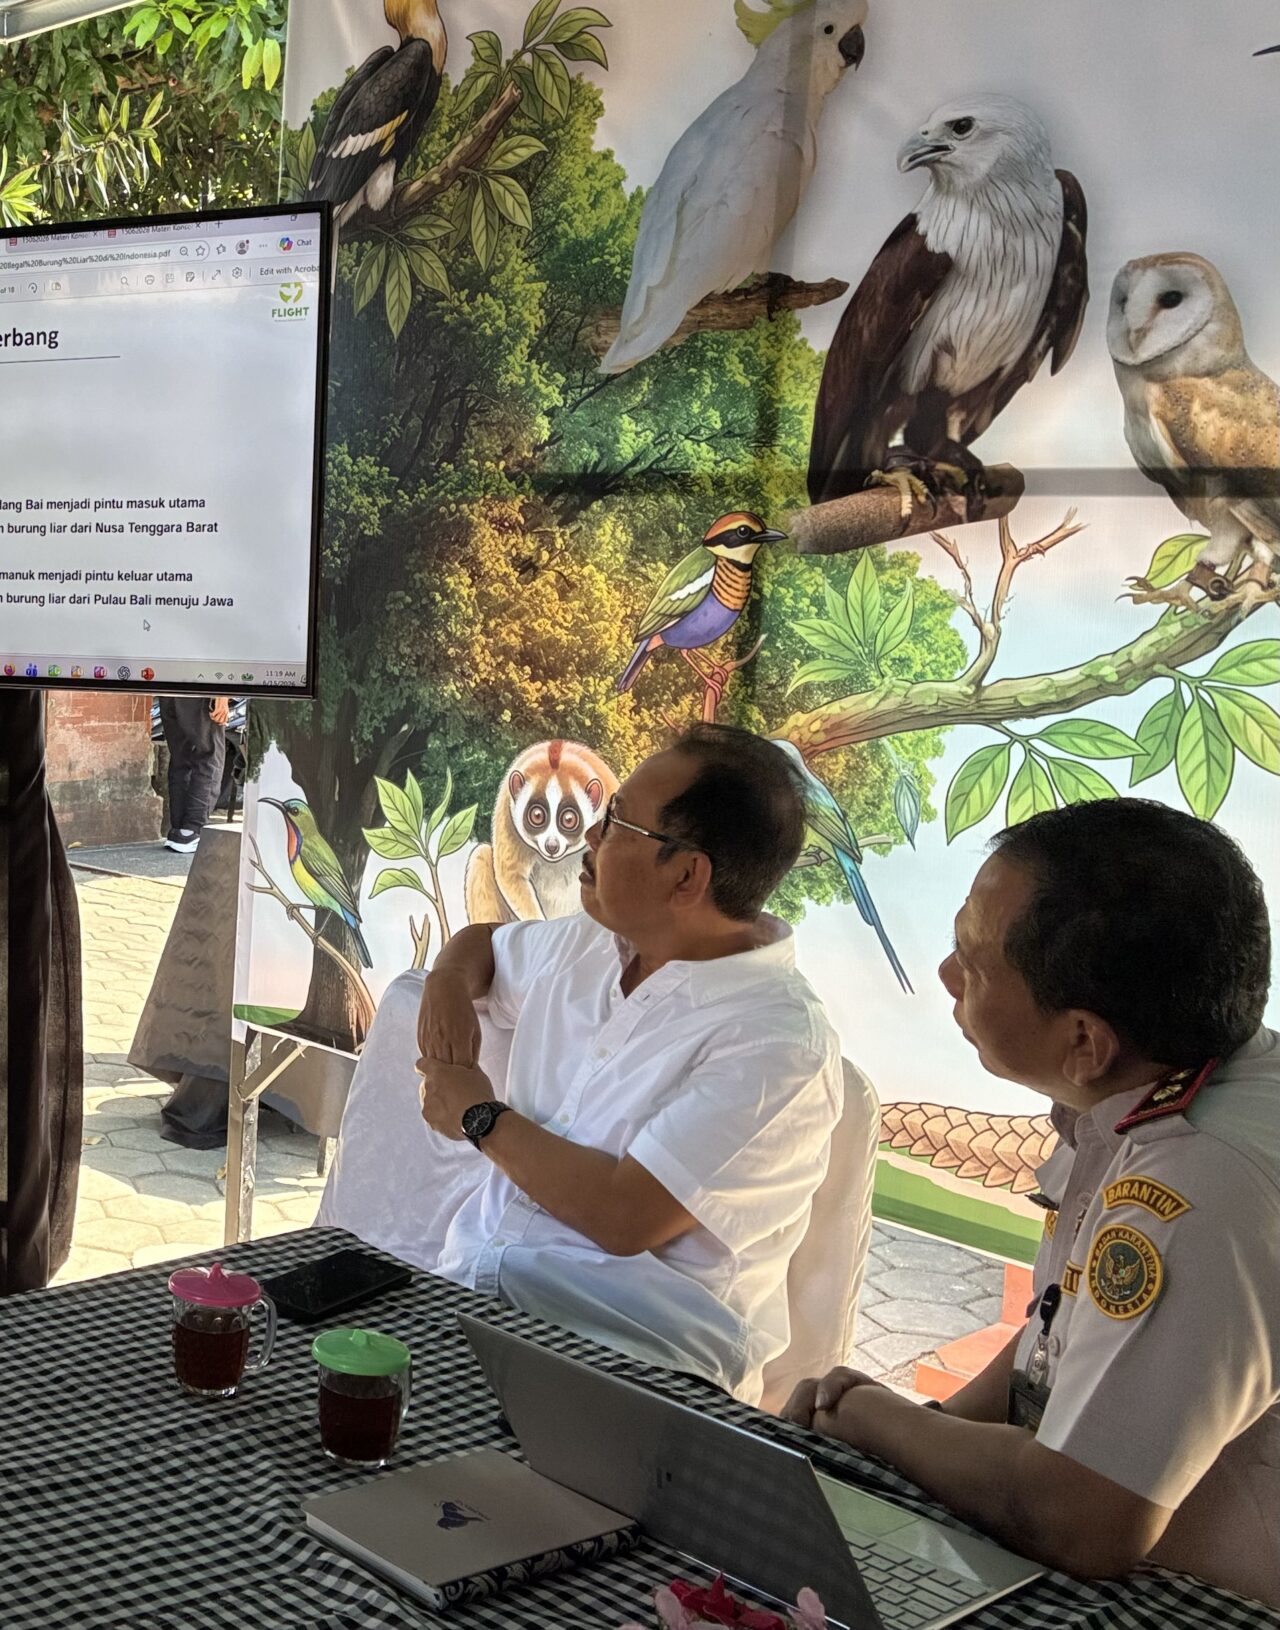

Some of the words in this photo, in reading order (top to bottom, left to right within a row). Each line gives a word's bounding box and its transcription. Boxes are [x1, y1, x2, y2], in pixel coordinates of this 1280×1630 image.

[297, 239, 312, 247] Chat
[260, 267, 274, 276] Edit
[276, 266, 292, 275] with
[272, 307, 309, 318] FLIGHT
[25, 499, 43, 510] Bai
[46, 498, 90, 512] menjadi
[94, 498, 123, 512] pintu
[127, 497, 165, 509] masuk
[169, 499, 205, 508] utama
[7, 522, 46, 536] burung
[50, 522, 67, 533] liar
[70, 522, 92, 533] dari
[95, 522, 124, 533] Nusa
[128, 522, 182, 536] Tenggara
[186, 522, 218, 533] Barat
[38, 569, 82, 583] menjadi
[85, 570, 114, 583] pintu
[117, 570, 153, 582] keluar
[156, 572, 192, 582] utama
[6, 592, 45, 607] burung
[48, 593, 66, 604] liar
[69, 593, 90, 604] dari
[94, 594, 126, 605] Pulau
[130, 594, 151, 606] Bali
[155, 595, 199, 609] menuju
[202, 596, 234, 607] Jawa
[1108, 1182, 1178, 1214] BARANTIN
[1095, 1231, 1116, 1257] BADAN
[1091, 1271, 1149, 1314] INDONESIA
